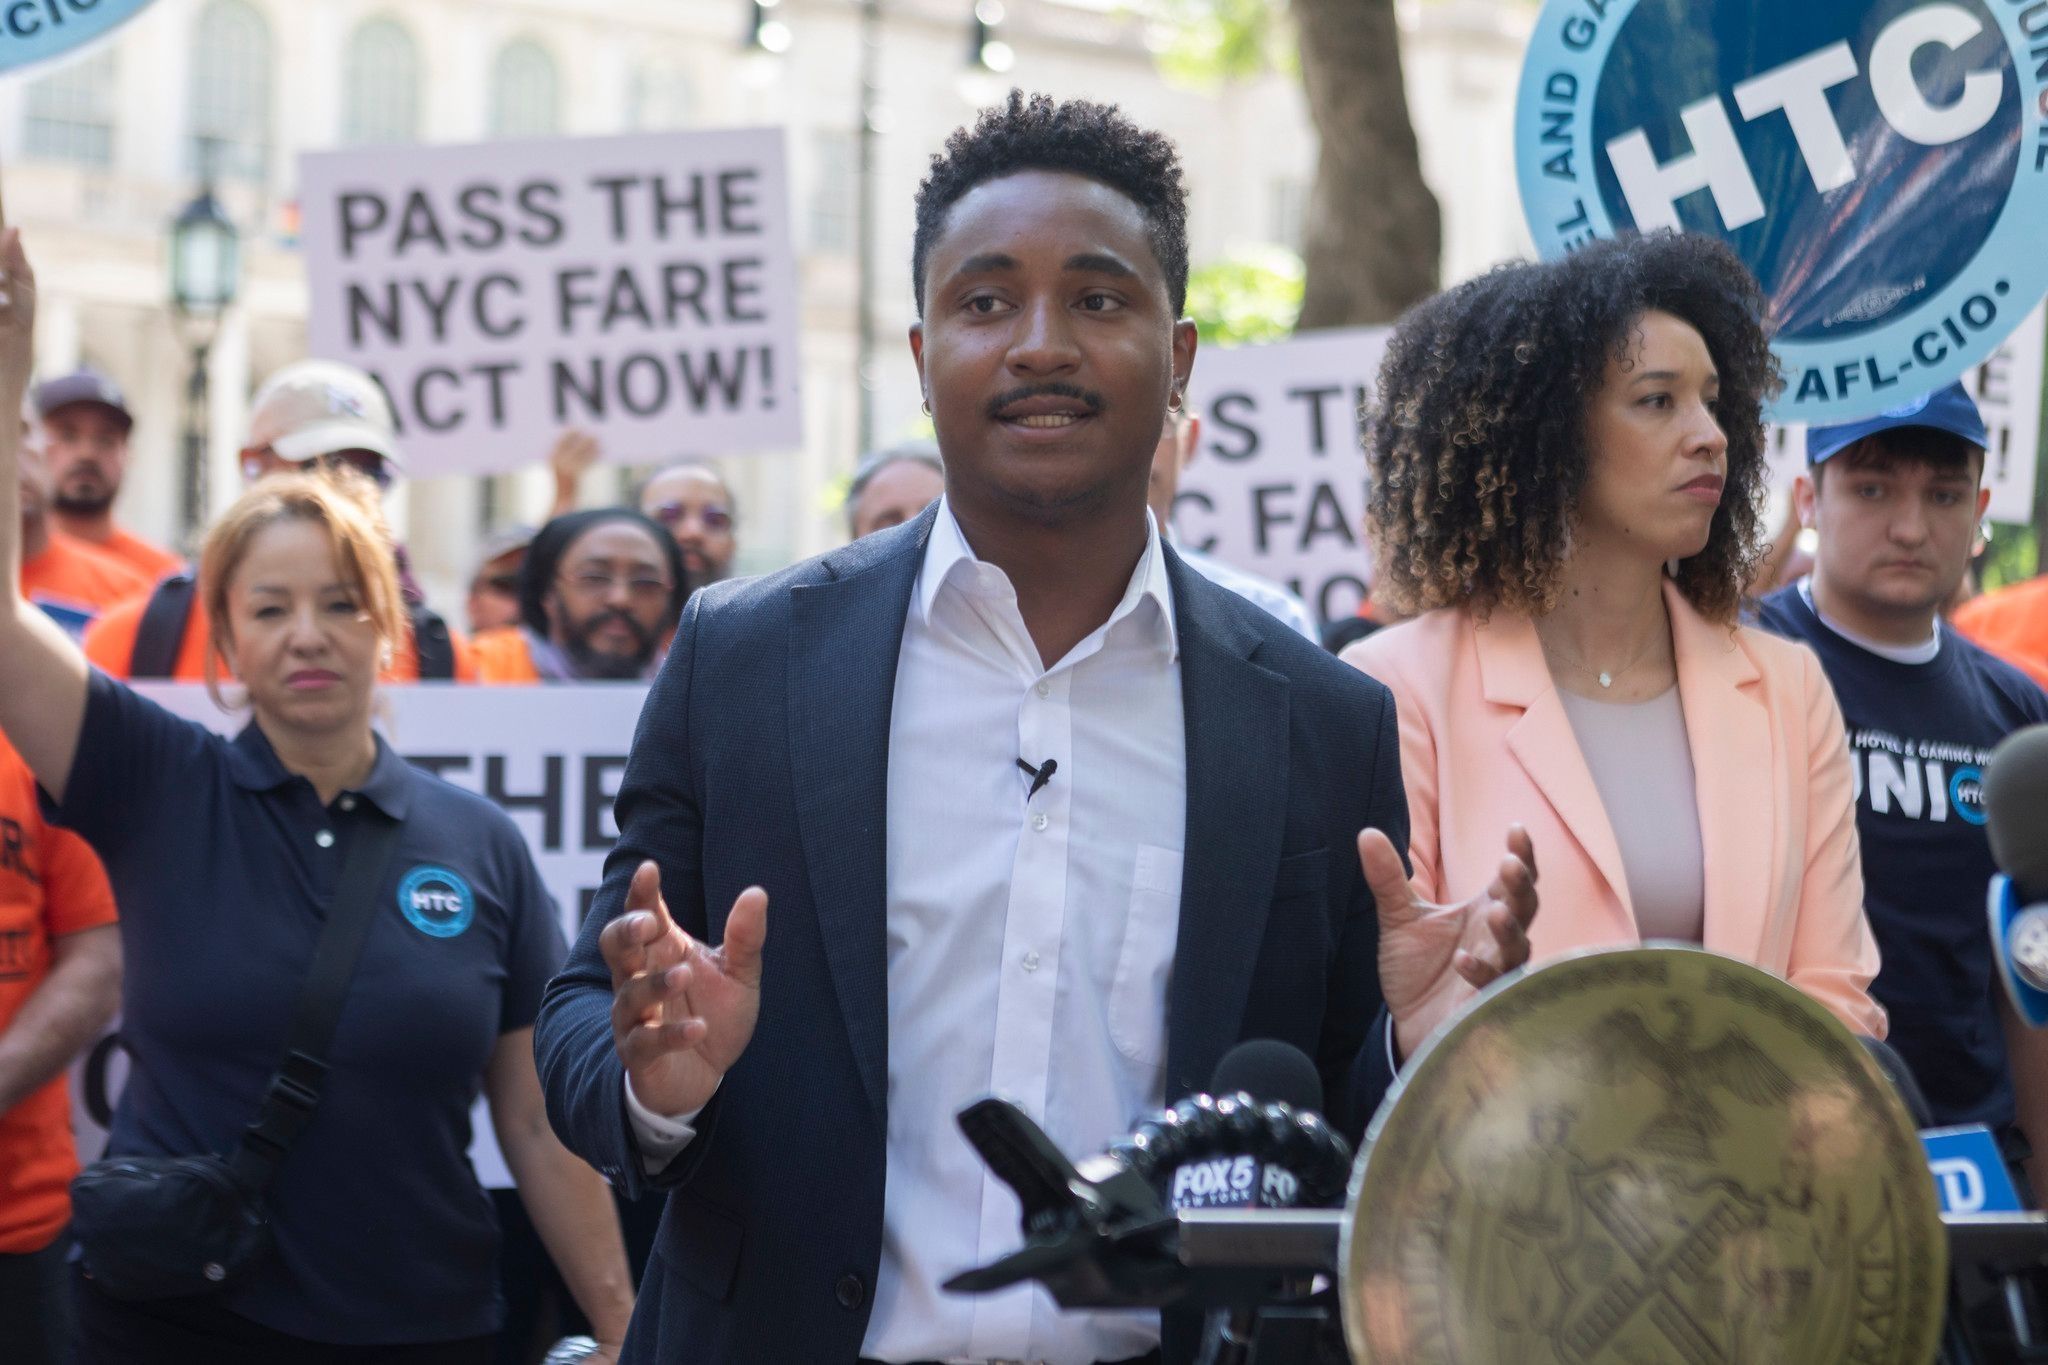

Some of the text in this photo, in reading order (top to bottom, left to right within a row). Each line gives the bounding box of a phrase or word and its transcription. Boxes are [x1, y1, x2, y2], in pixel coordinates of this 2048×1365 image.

[1541, 72, 1578, 182] AND
[1606, 3, 2003, 234] HTC
[336, 167, 762, 257] PASS THE
[346, 257, 767, 346] NYC FARE
[552, 344, 776, 421] NOW!
[1793, 295, 1998, 404] AFL-CIO
[1286, 385, 1367, 455] T
[1252, 481, 1366, 554] FA
[1855, 731, 1902, 754] HOTEL
[1918, 740, 1973, 763] GAMING
[410, 890, 463, 912] HTC
